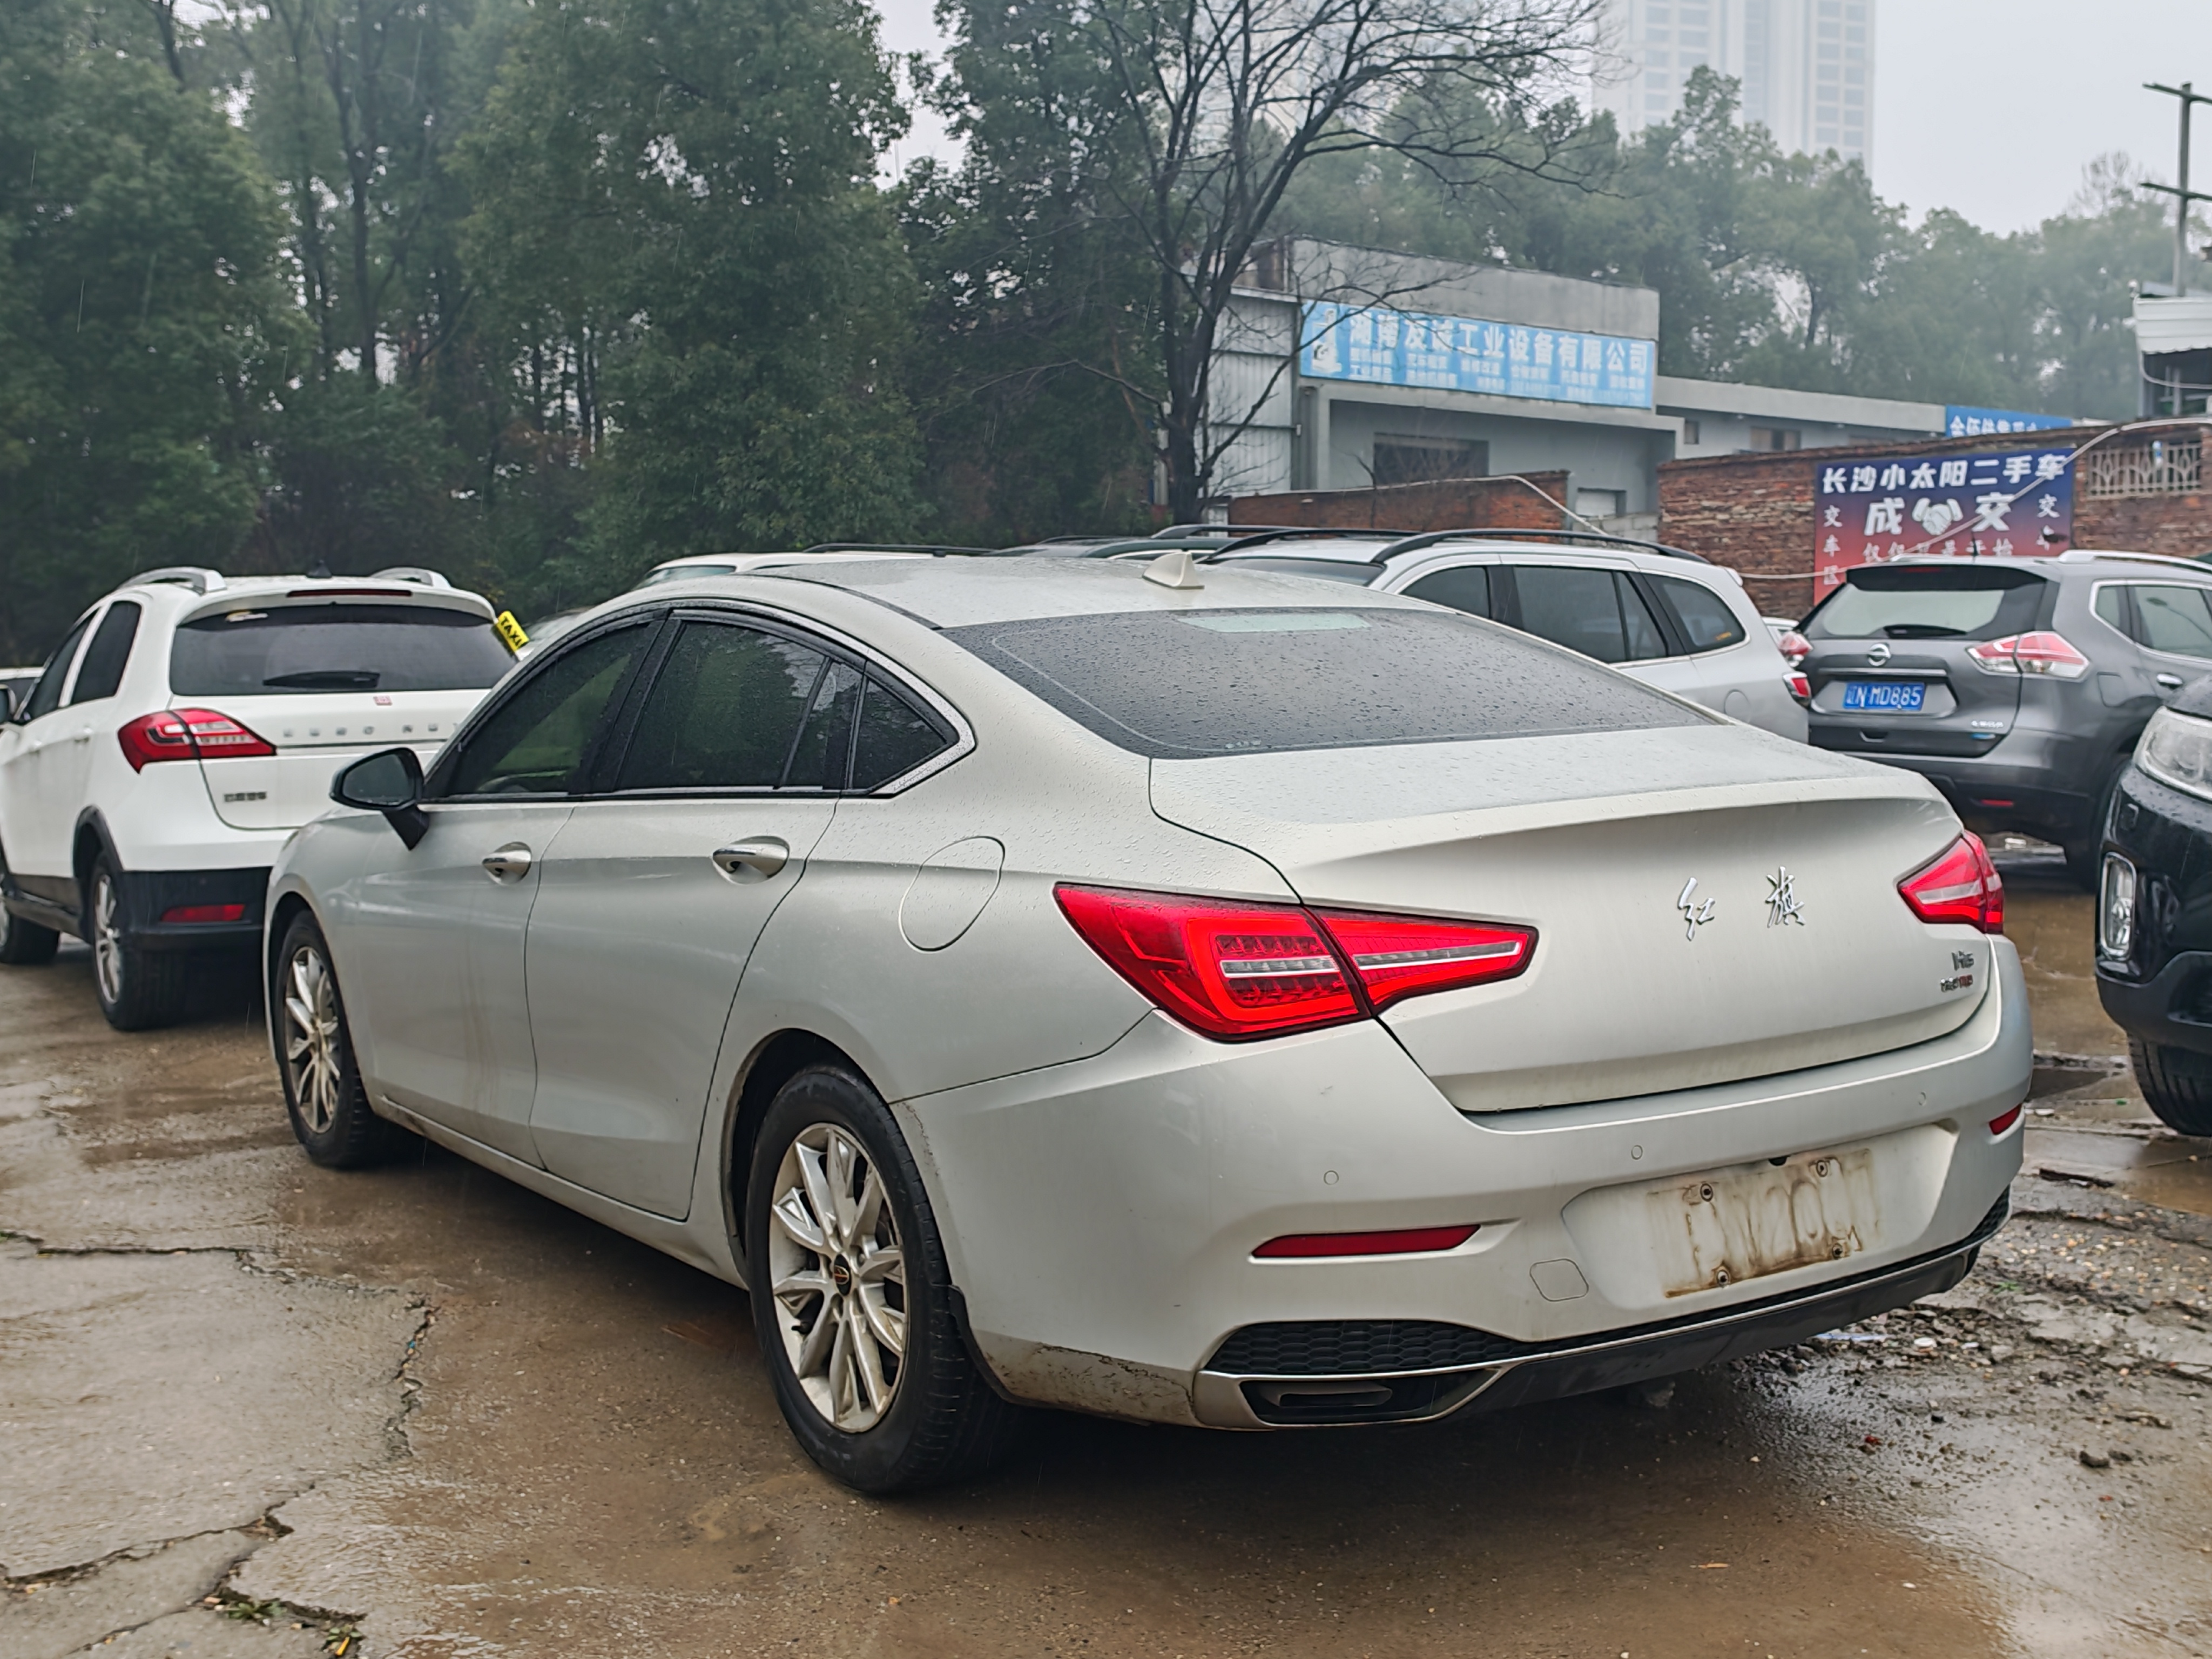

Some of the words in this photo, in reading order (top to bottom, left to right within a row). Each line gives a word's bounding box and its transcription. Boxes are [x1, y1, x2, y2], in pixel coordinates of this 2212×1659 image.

[1822, 454, 2066, 494] 长沙小太阳二手车
[501, 616, 523, 646] TAXI
[1677, 866, 1805, 941] 红旗
